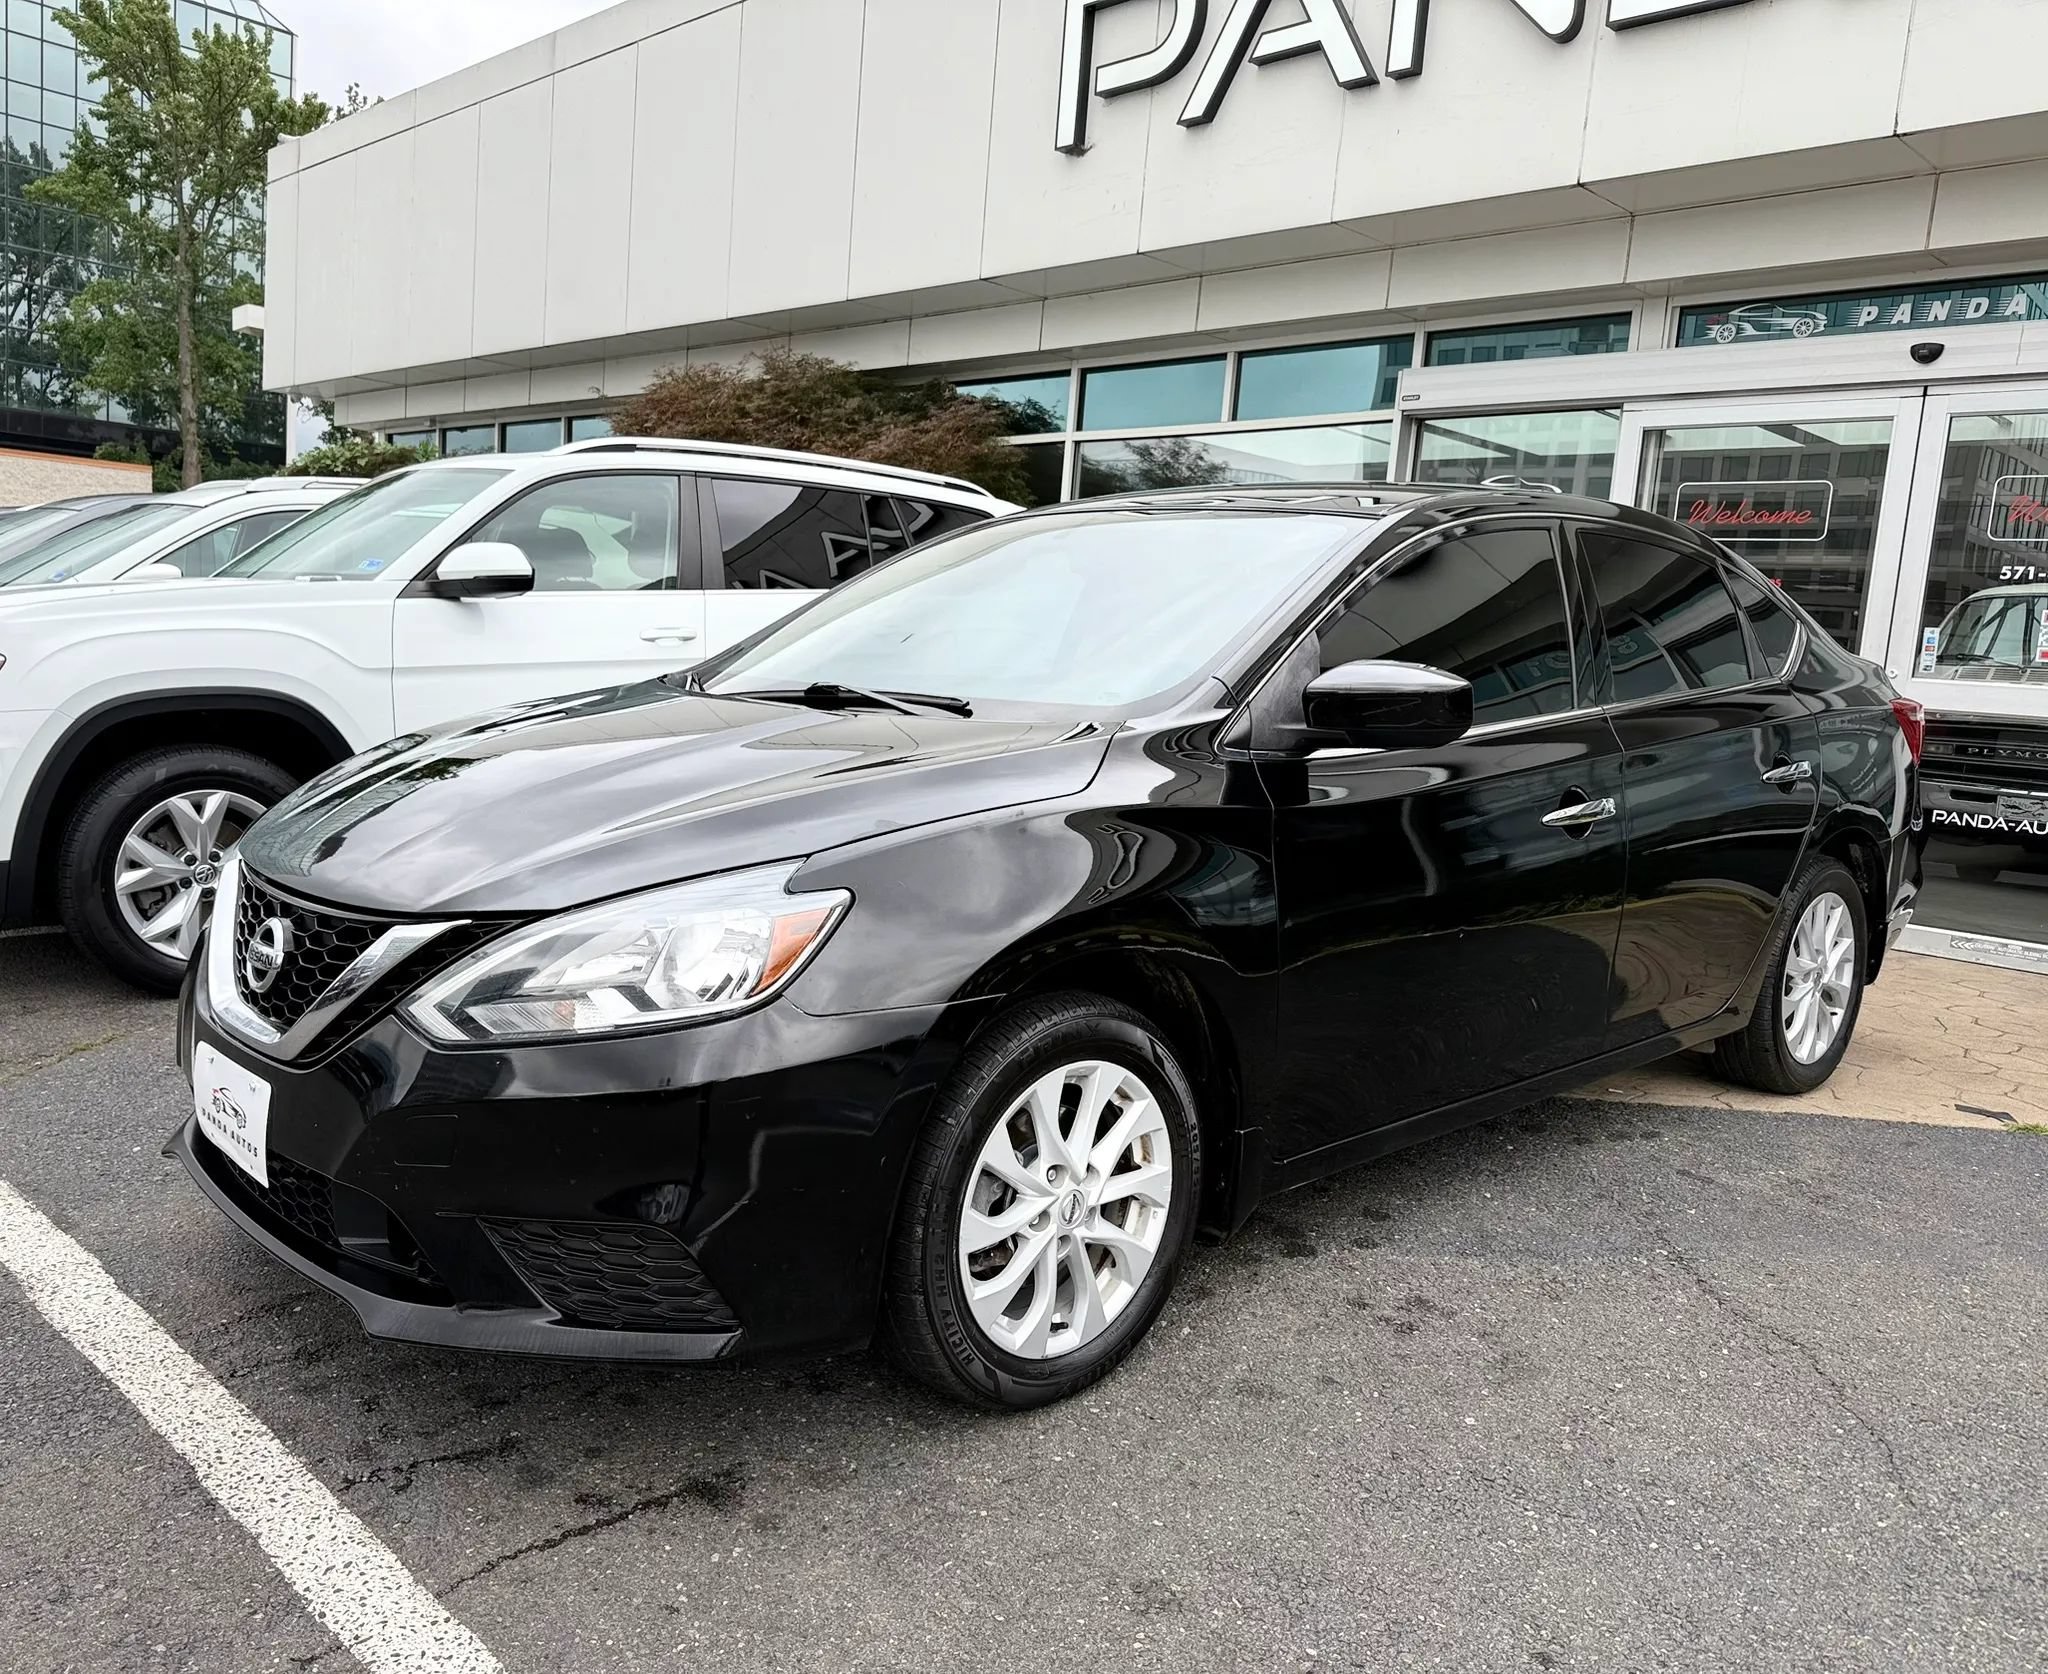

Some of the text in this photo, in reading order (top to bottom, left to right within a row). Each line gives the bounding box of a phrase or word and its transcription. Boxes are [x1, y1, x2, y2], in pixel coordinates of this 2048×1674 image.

[1054, 0, 1758, 153] PA
[1857, 293, 2027, 328] PANDA
[1688, 498, 1814, 526] Welcome
[1931, 809, 2048, 835] PANDA-AU
[201, 1106, 227, 1134] PANDA
[231, 1130, 258, 1158] AUTOS
